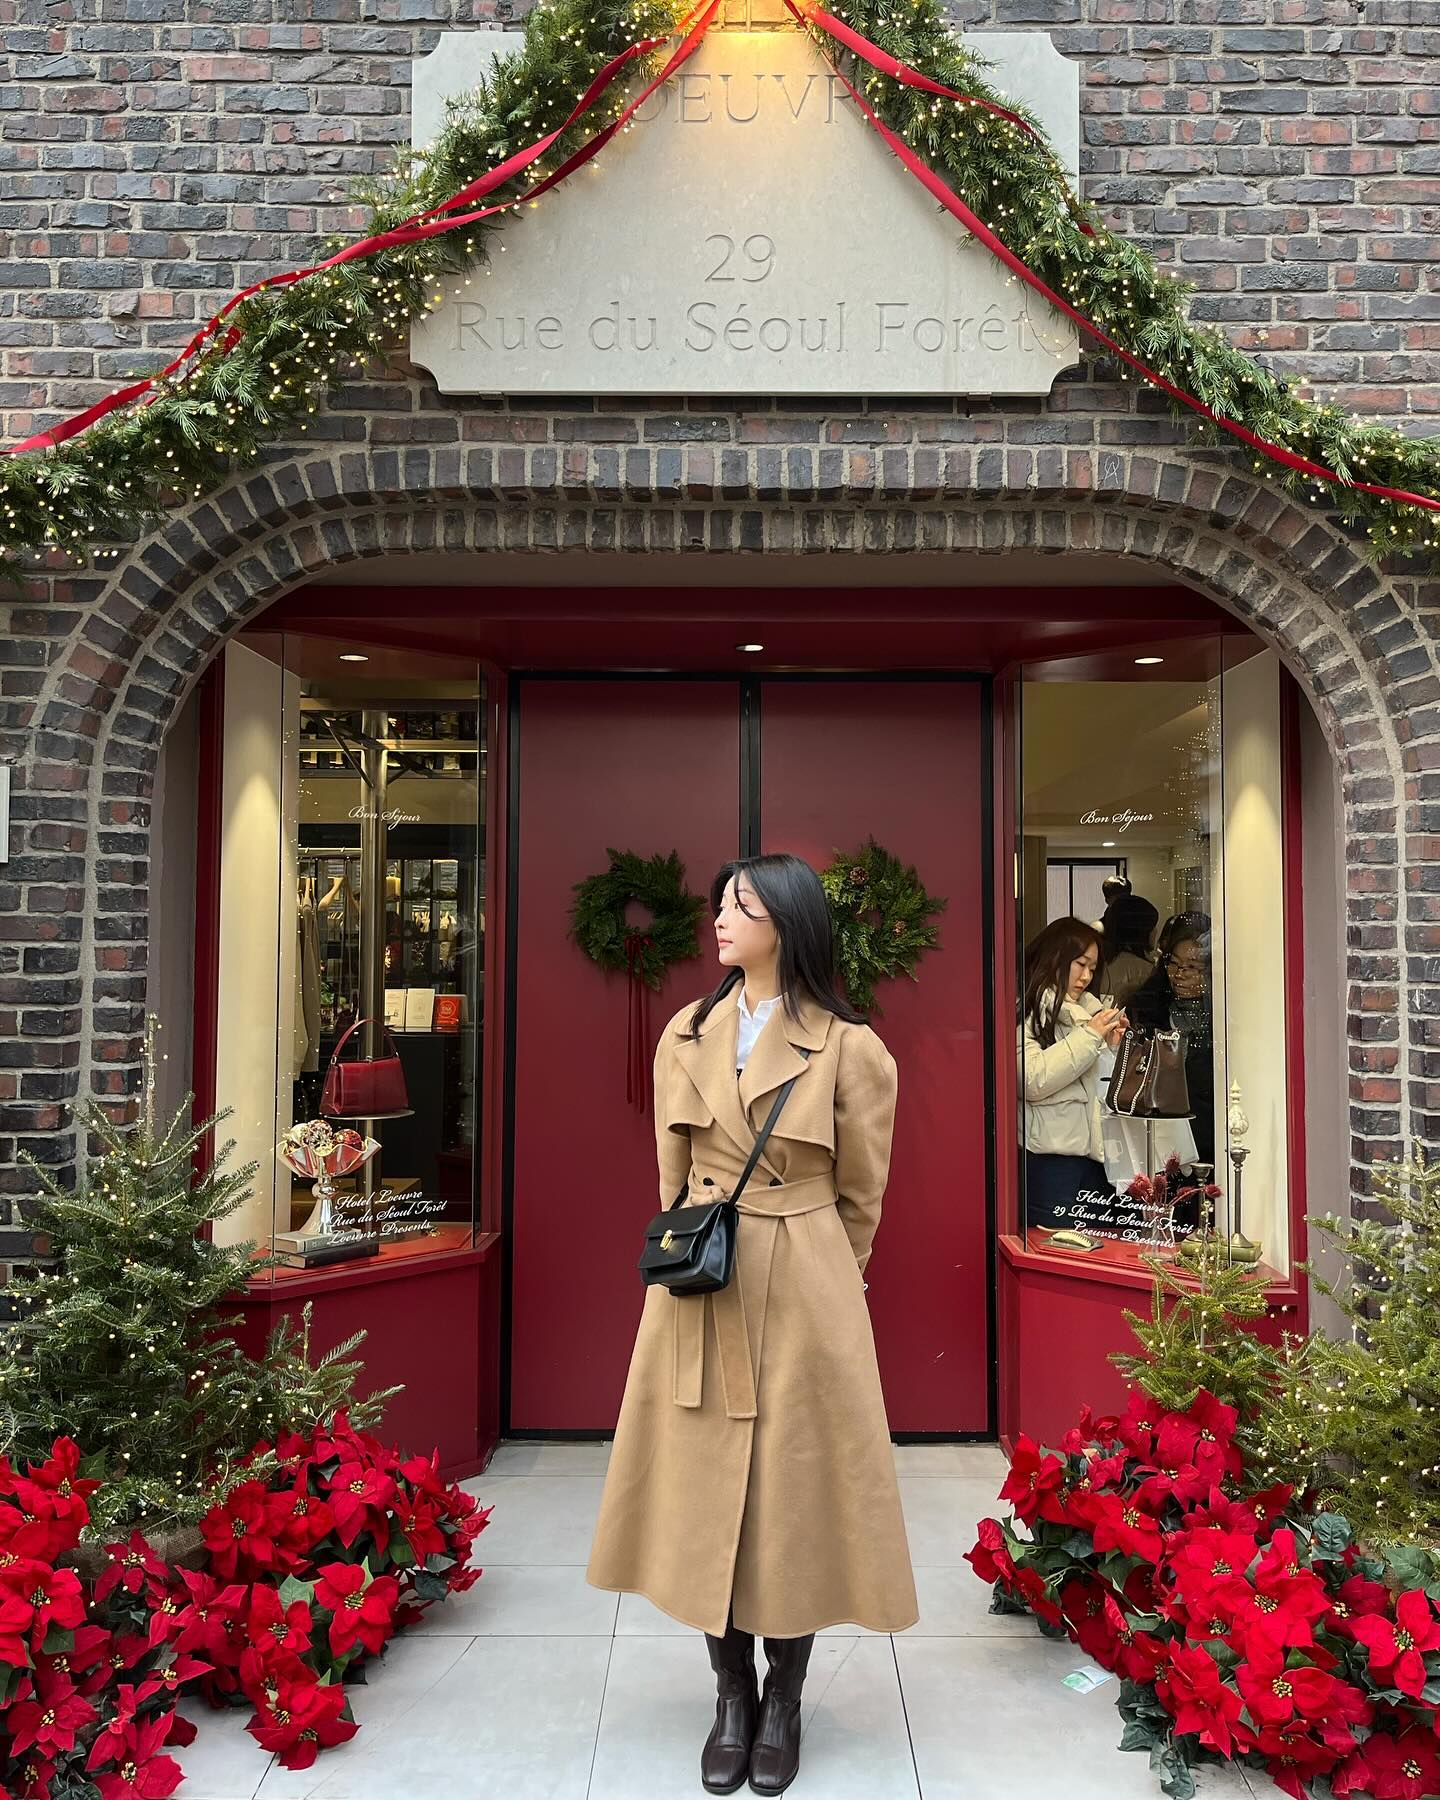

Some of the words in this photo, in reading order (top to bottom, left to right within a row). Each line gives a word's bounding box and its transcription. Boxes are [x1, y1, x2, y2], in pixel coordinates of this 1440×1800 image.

[704, 233, 778, 283] 29
[451, 301, 565, 351] Rue
[588, 300, 660, 351] du
[684, 301, 849, 352] Séoul
[874, 301, 1035, 352] Forêt
[348, 804, 379, 819] Bon
[381, 807, 421, 831] Séjour
[1080, 808, 1109, 824] Bon
[1111, 808, 1153, 832] Séjour
[335, 1192, 375, 1210] Hotel
[375, 1189, 423, 1204] Loeuvre
[1076, 1189, 1115, 1206] Hotel
[1115, 1194, 1165, 1214] Loeuvre
[330, 1211, 356, 1228] Rue
[357, 1208, 374, 1223] du
[376, 1202, 415, 1222] Séoul
[415, 1200, 447, 1215] Forêt
[1052, 1205, 1066, 1217] 29
[1068, 1204, 1097, 1221] Rue
[1098, 1208, 1114, 1223] du
[1116, 1212, 1159, 1229] Séoul
[1156, 1217, 1194, 1234] Forêt
[327, 1229, 377, 1245] Loeuvre
[380, 1219, 431, 1237] Presents
[1073, 1220, 1118, 1240] Loeuvre
[1120, 1228, 1176, 1248] Presents
